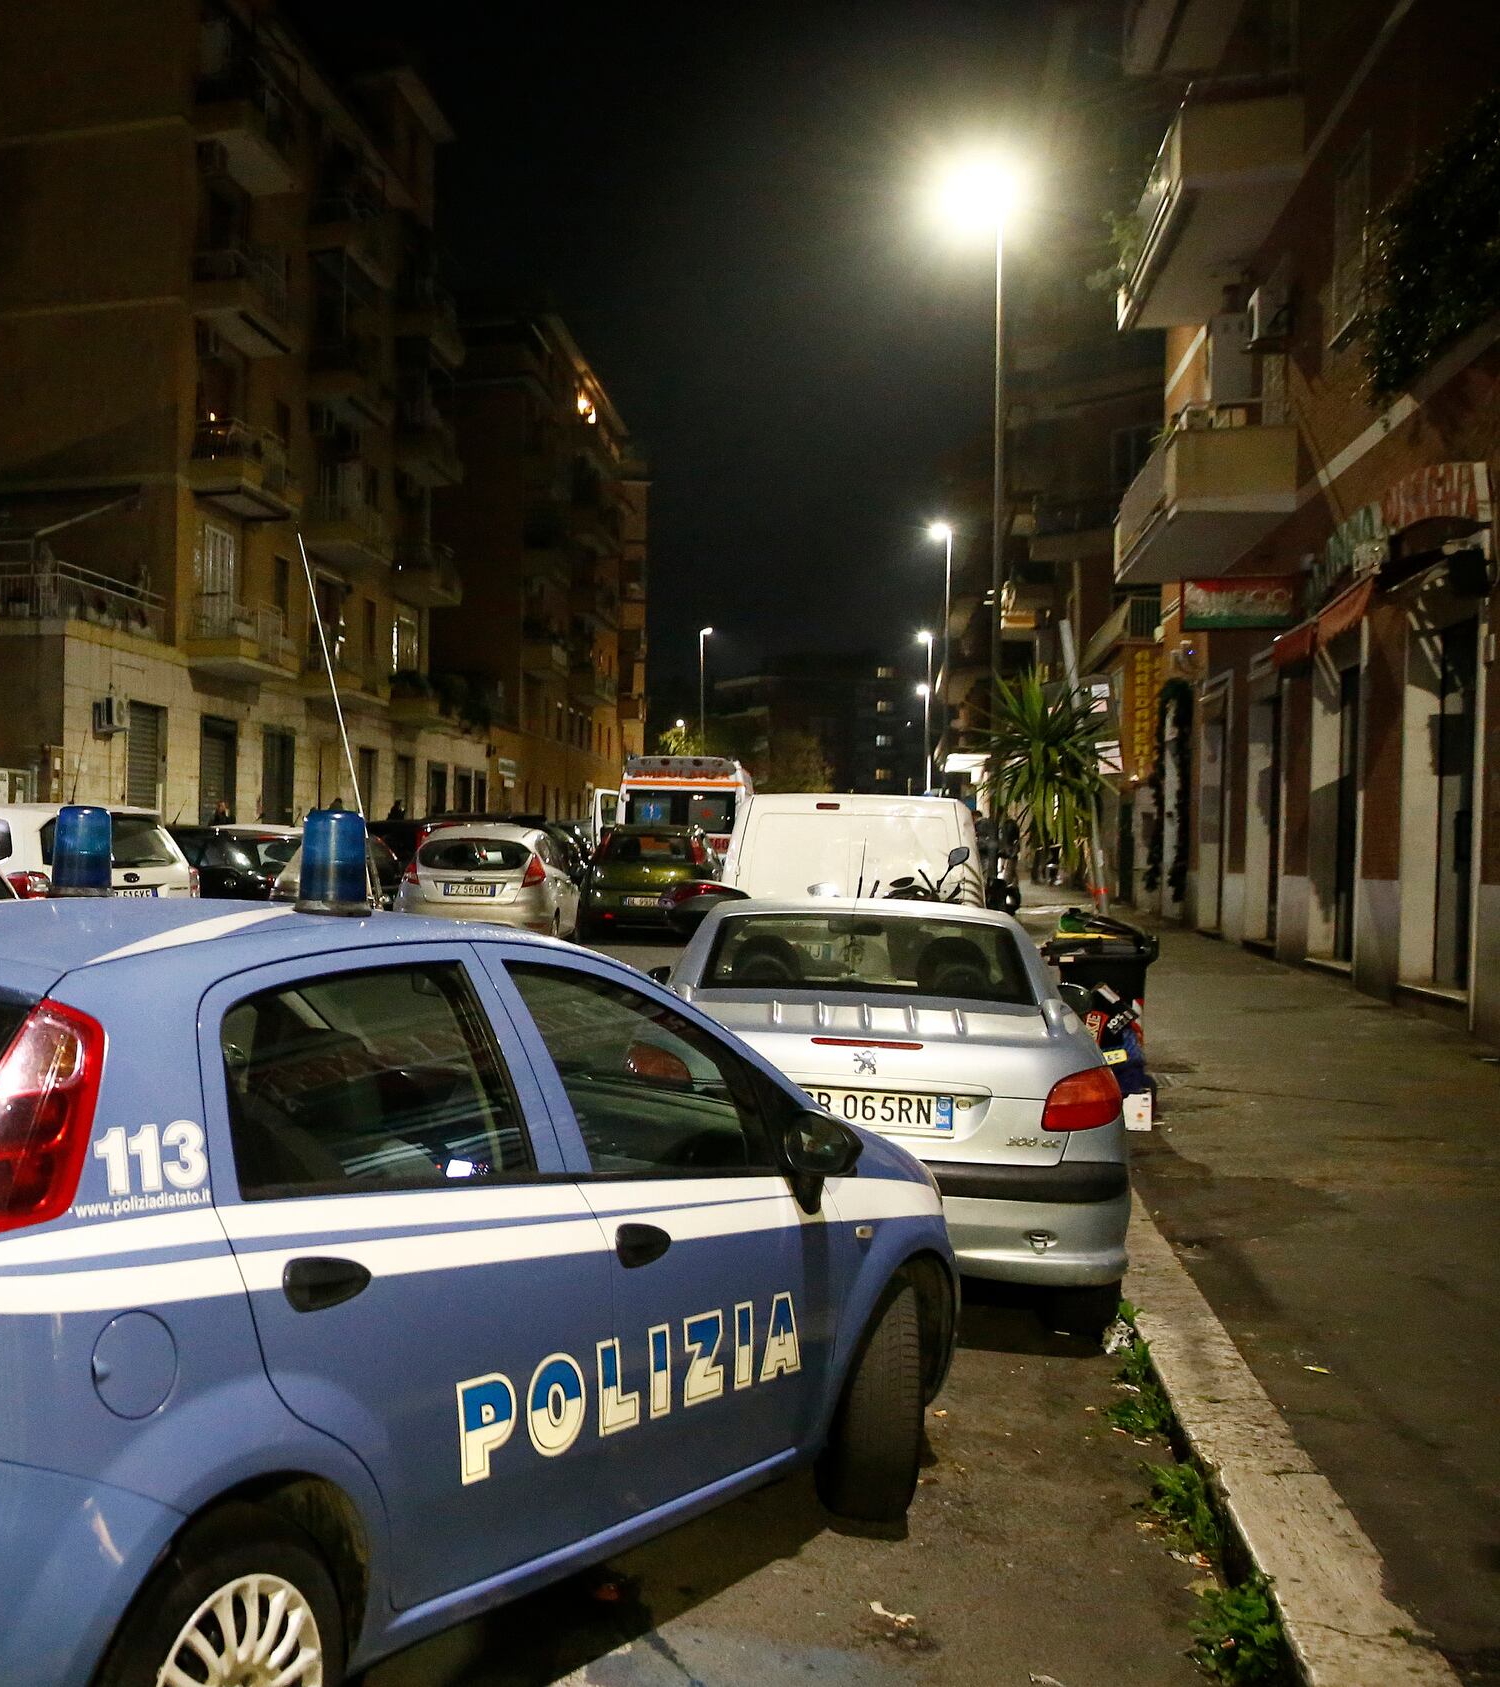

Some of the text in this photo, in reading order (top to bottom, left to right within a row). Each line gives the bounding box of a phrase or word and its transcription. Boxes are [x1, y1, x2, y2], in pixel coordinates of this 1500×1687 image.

[843, 1094, 932, 1125] 065RN
[94, 1120, 208, 1196] 113
[75, 1188, 212, 1218] www.poliziadistato.it
[456, 1290, 801, 1487] POLIZIA
